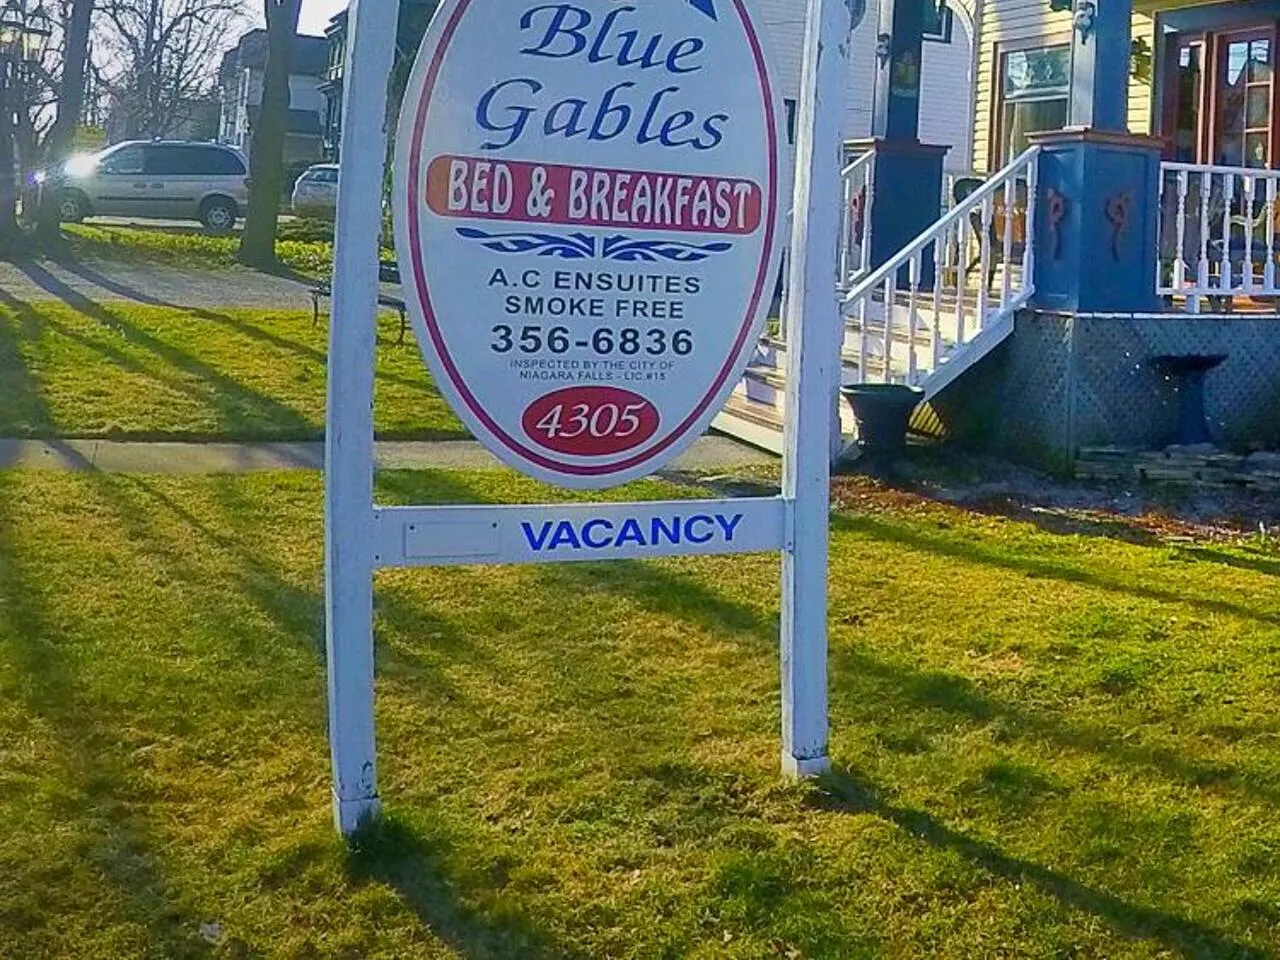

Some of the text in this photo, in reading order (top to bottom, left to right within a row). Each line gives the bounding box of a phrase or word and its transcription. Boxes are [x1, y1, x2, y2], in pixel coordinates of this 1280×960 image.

[519, 4, 704, 73] Blue
[475, 78, 729, 150] Gables
[447, 159, 752, 229] BED & BREAKFAST
[488, 268, 700, 294] A.C ENSUITES
[505, 295, 684, 319] SMOKE FREE
[490, 324, 693, 355] 356-6836
[509, 359, 675, 371] INSPECTED BY THE CITY OF
[519, 370, 575, 380] NIAGARA
[578, 370, 613, 380] FALLS
[535, 402, 648, 438] 4305
[523, 513, 743, 550] VACANCY
